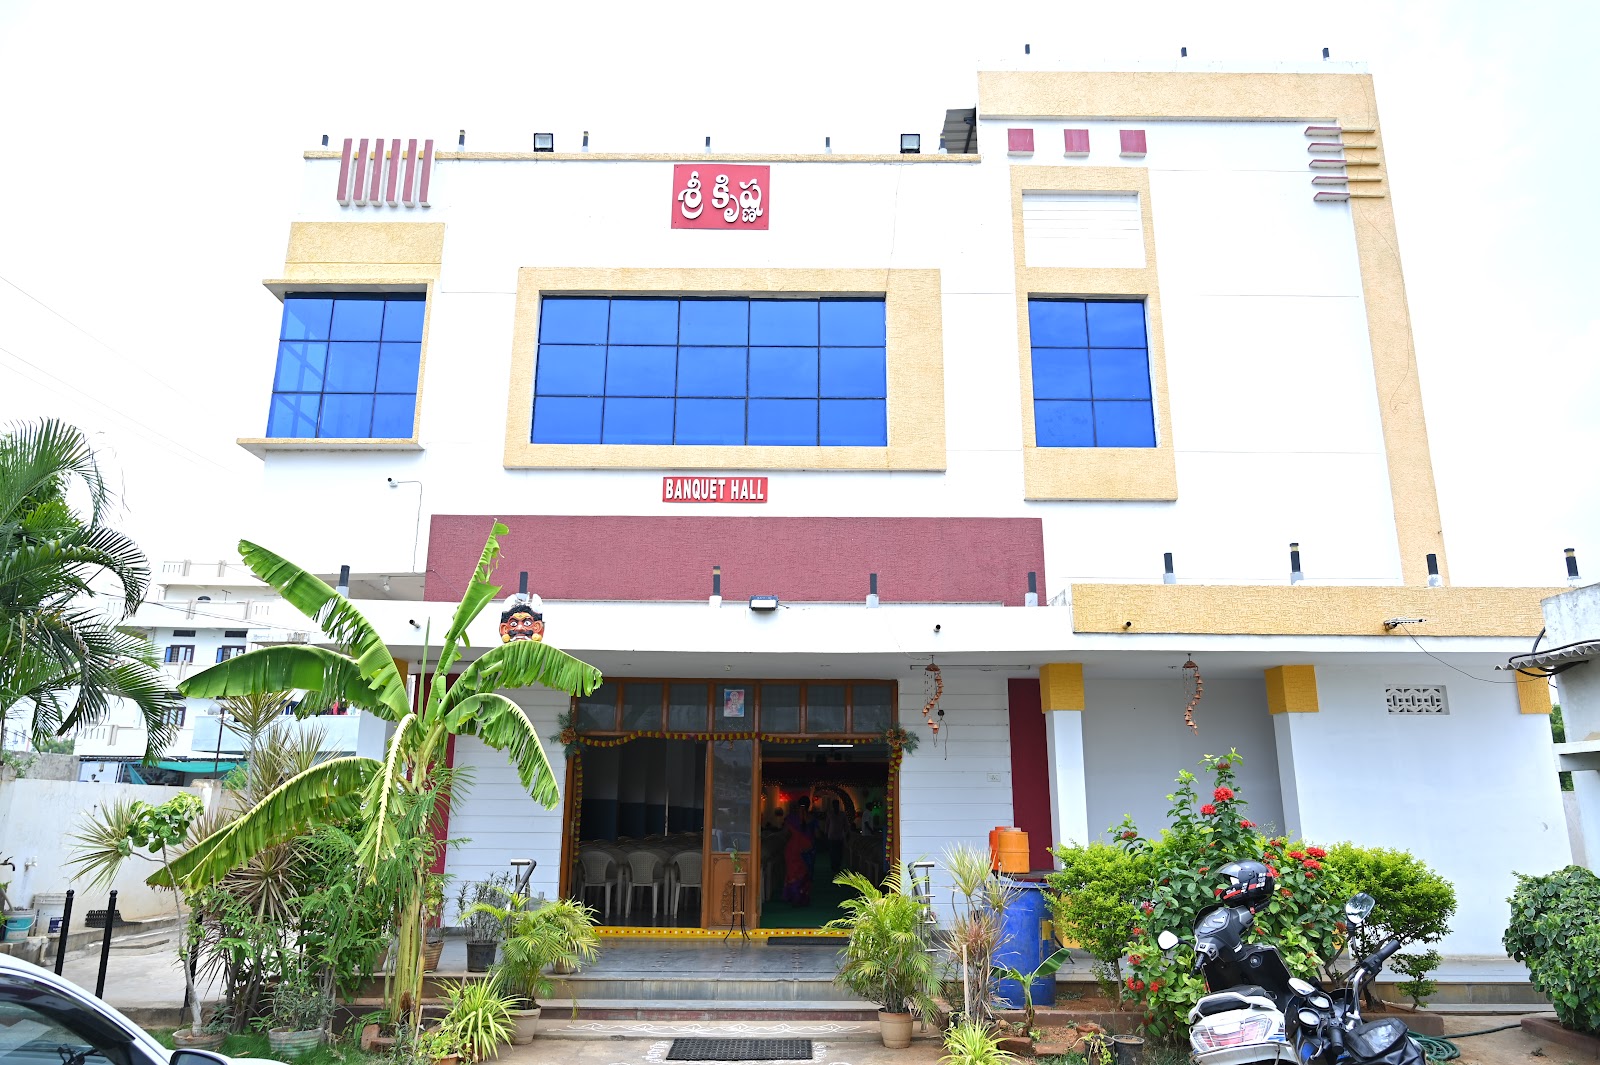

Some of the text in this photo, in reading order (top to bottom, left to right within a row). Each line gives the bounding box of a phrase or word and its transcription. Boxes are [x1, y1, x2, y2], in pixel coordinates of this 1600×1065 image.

[677, 170, 704, 220] శ్రీ
[665, 478, 764, 501] BANQUET HALL
